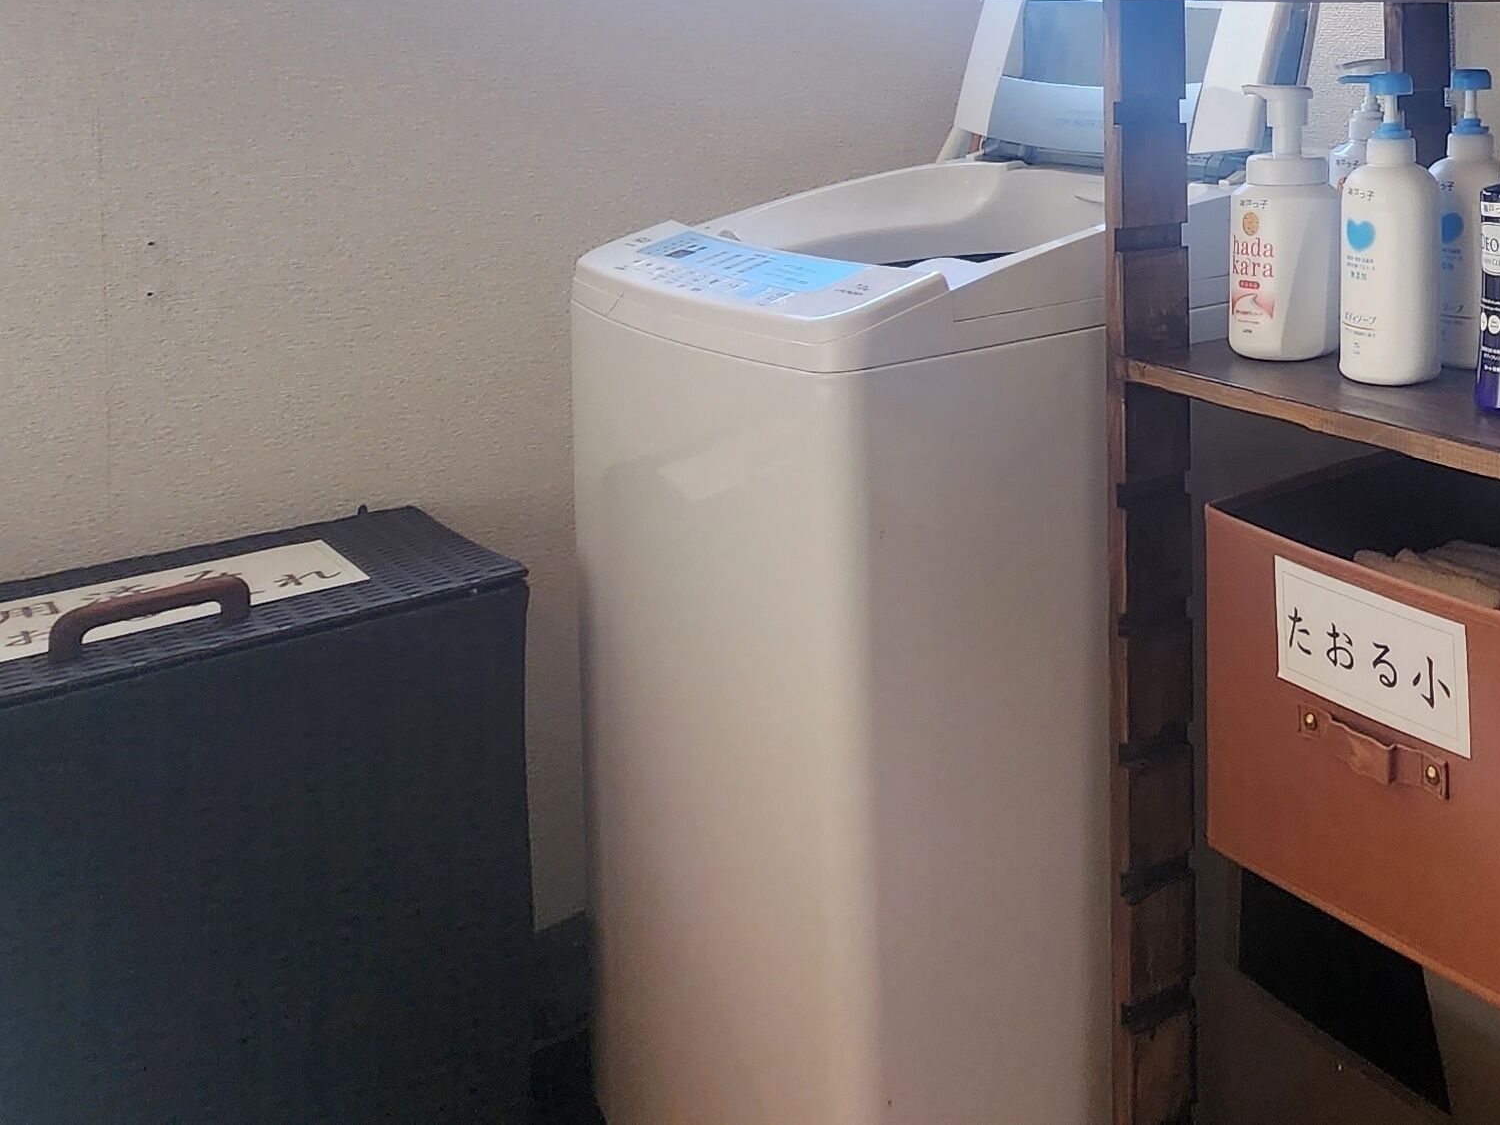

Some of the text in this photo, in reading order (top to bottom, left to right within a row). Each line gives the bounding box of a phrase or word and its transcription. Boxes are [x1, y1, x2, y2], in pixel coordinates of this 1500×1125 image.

[1232, 234, 1275, 258] hada
[1231, 254, 1275, 278] kara
[1287, 606, 1451, 709] たおる小
